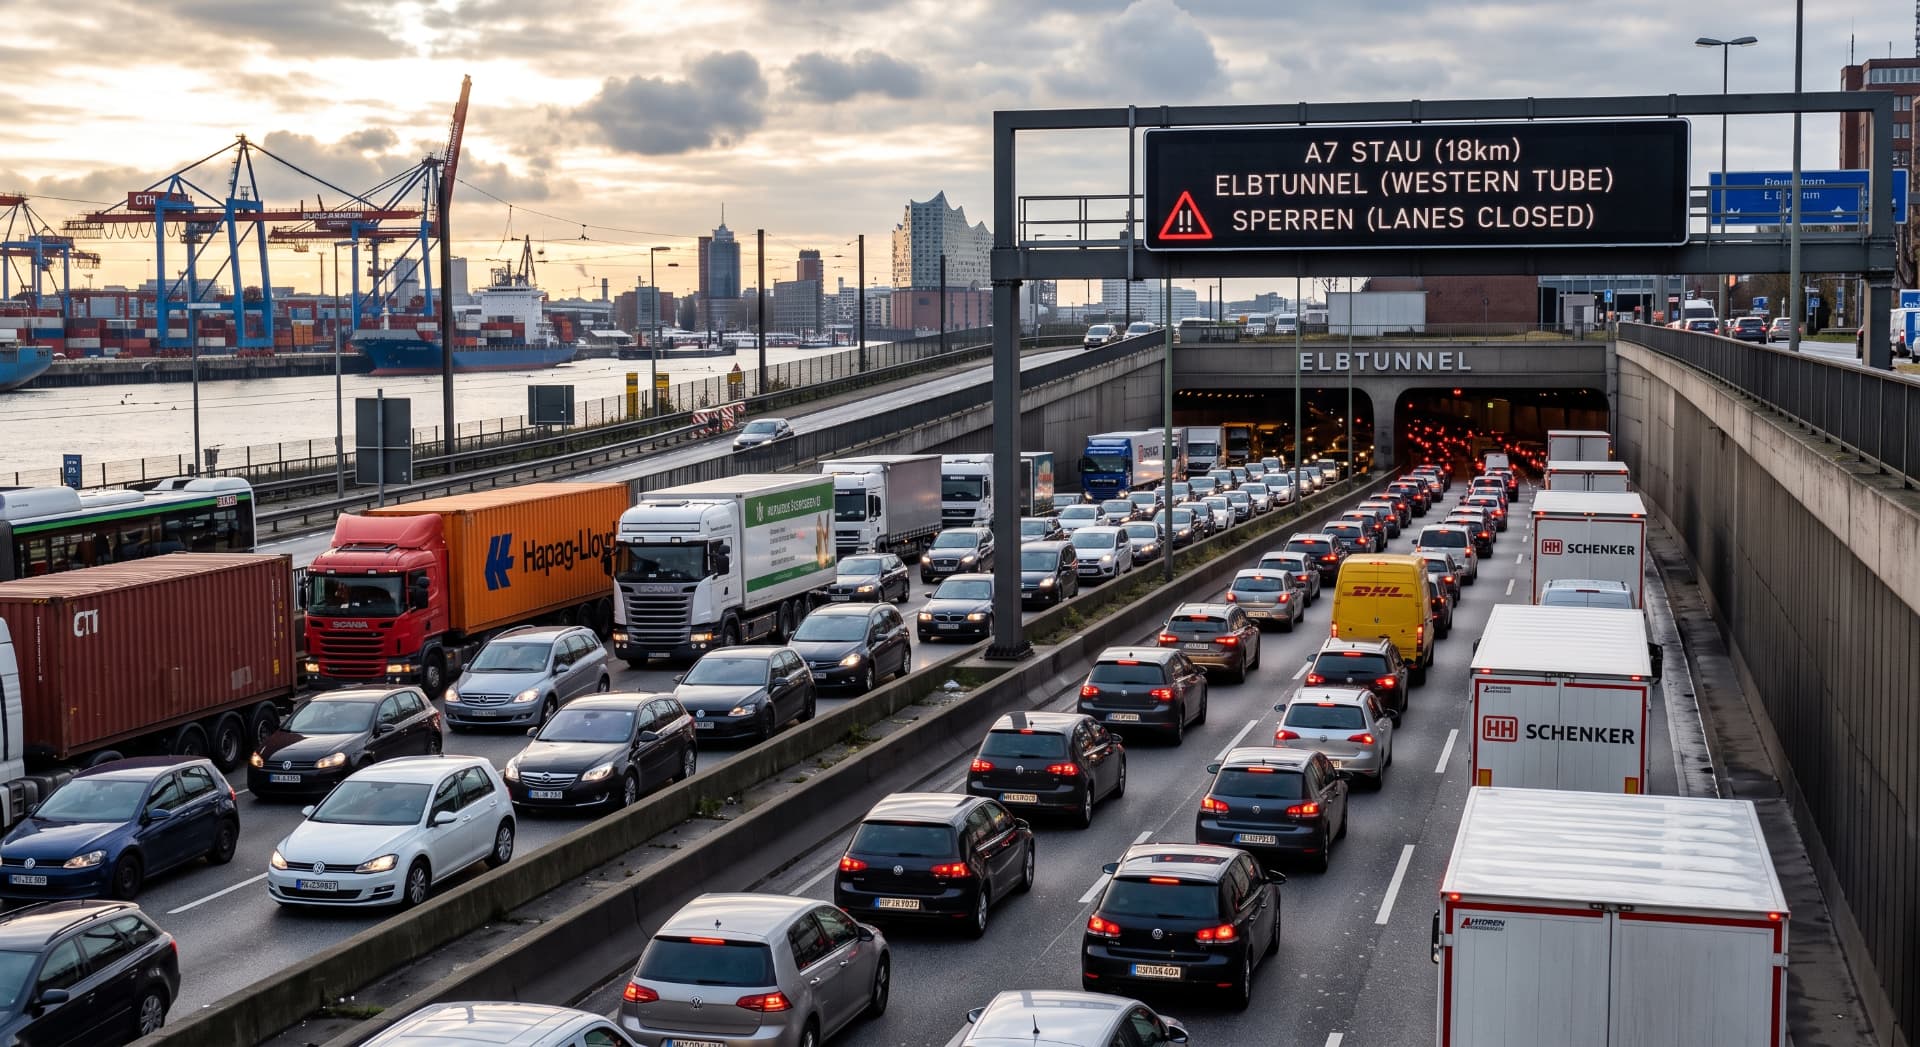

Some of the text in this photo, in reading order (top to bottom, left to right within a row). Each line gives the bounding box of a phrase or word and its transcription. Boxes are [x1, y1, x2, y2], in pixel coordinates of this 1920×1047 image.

[1304, 136, 1521, 165] A7 STAU (18km)
[1216, 166, 1613, 197] ELBTUNNEL (WESTERN TUBE)
[136, 194, 156, 206] CTH
[1232, 204, 1594, 233] SPERREN (LANES CLOSED)
[1299, 351, 1472, 372] ELBTUNNEL
[1567, 543, 1635, 556] SCHENKER
[1351, 585, 1404, 598] DHL
[333, 621, 369, 629] SCANIA
[1525, 723, 1636, 746] SCHENKER
